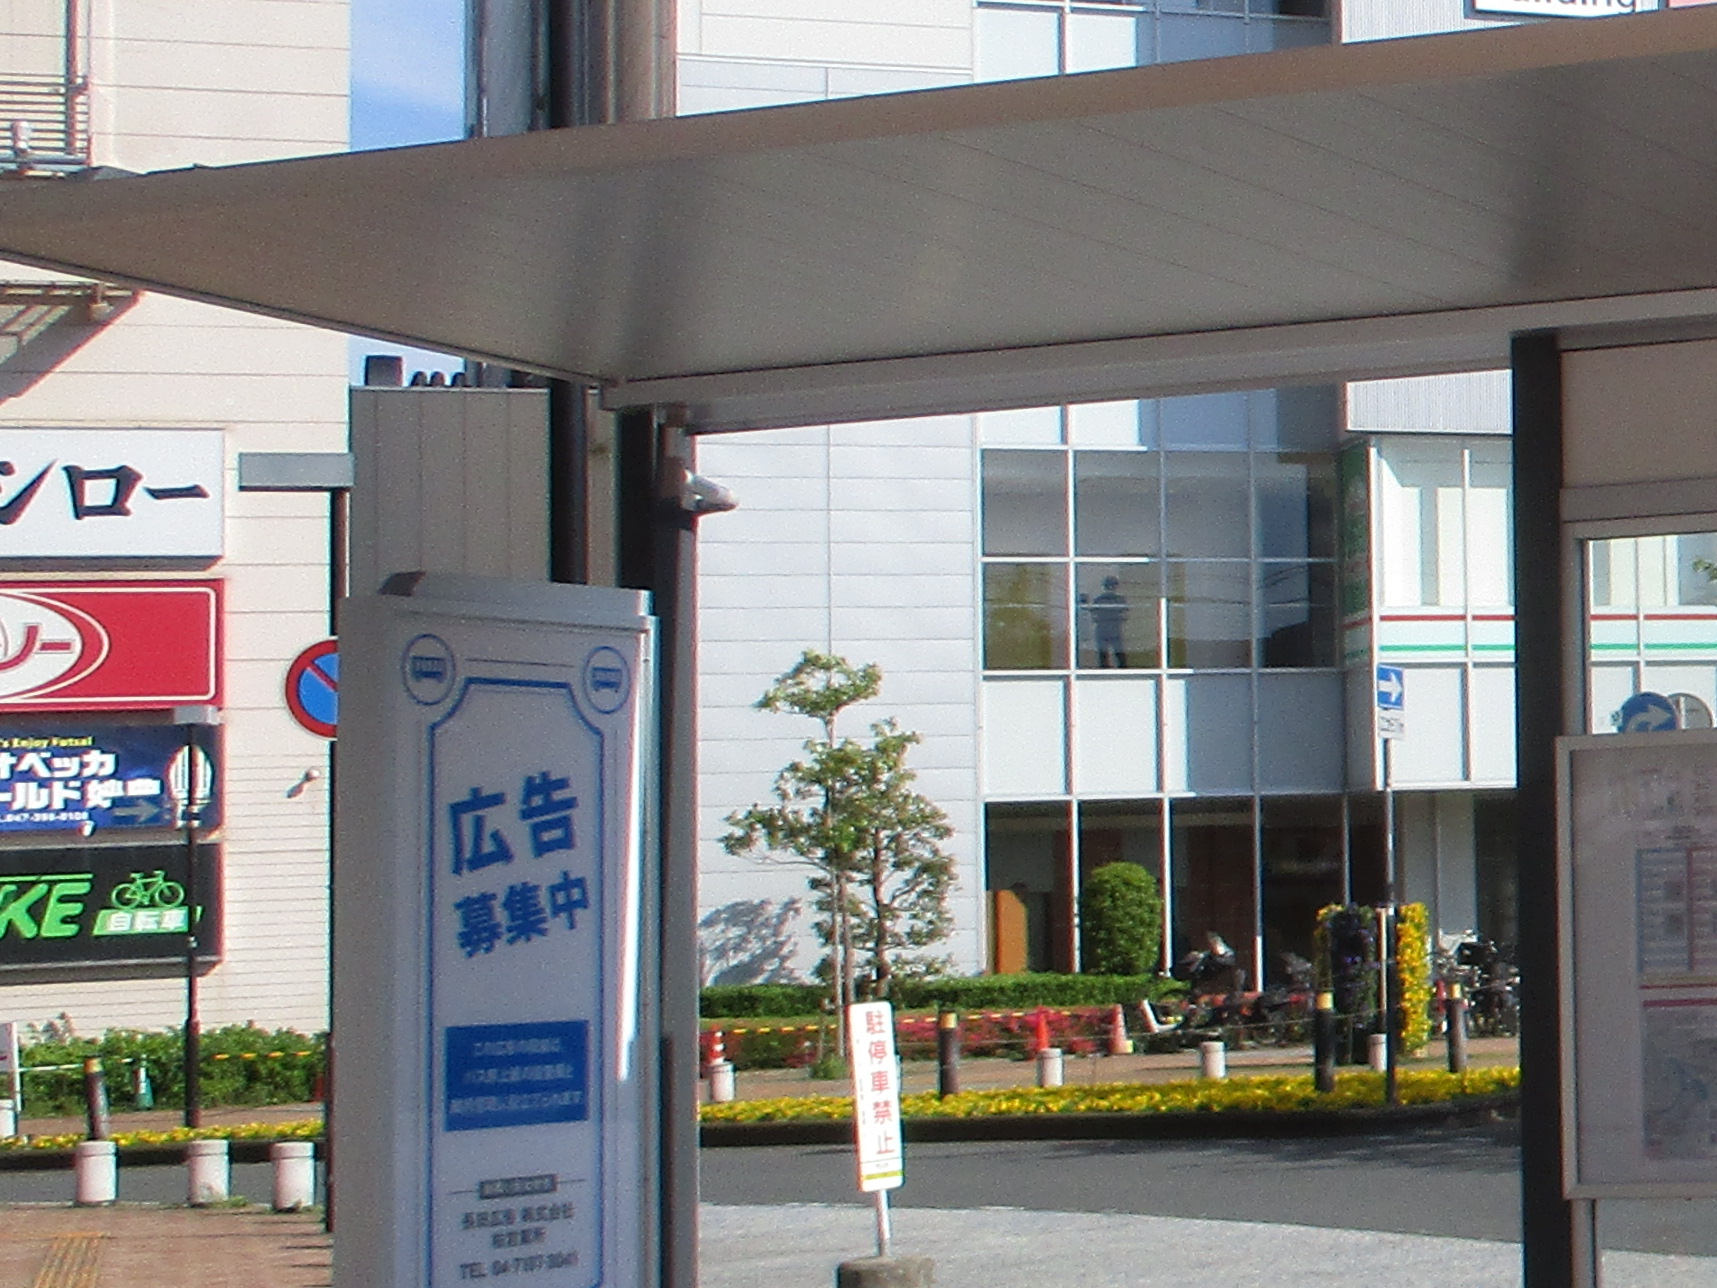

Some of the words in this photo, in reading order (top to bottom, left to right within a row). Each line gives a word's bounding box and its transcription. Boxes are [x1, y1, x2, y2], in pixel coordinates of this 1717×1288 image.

[448, 770, 579, 877] 広告
[453, 869, 591, 959] 募集中
[865, 1010, 896, 1156] 駐停車禁止
